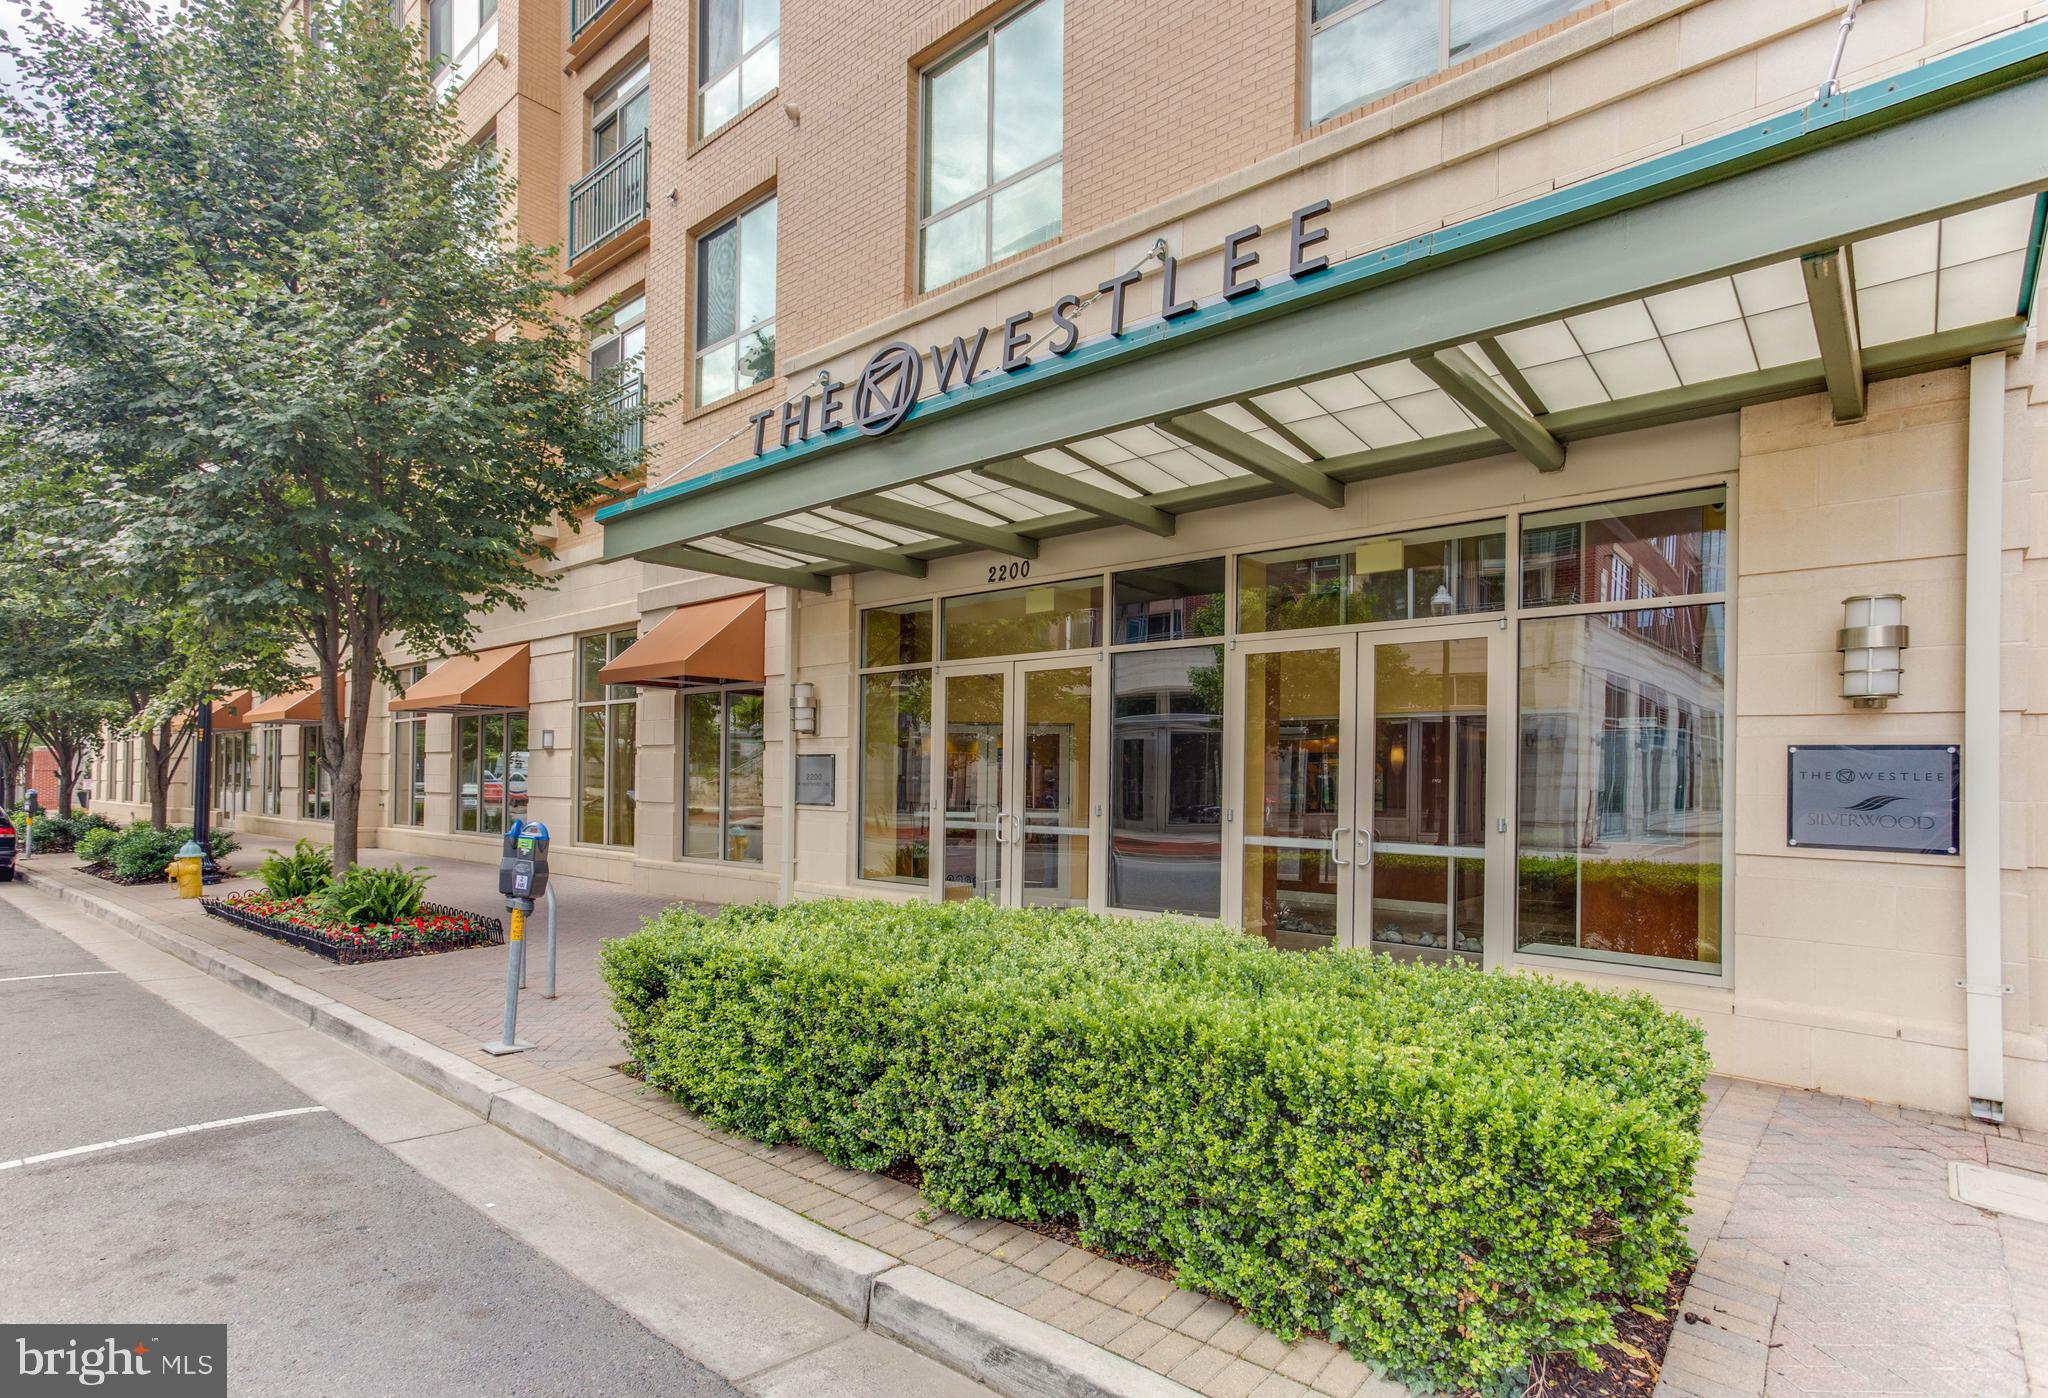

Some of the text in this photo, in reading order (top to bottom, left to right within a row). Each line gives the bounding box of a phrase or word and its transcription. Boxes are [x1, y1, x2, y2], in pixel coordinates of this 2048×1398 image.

[749, 199, 1331, 456] THE WESTLEE
[987, 560, 1030, 583] 2200
[1800, 771, 1945, 782] THE WESTLEE
[1807, 812, 1936, 830] SILVERWOOD
